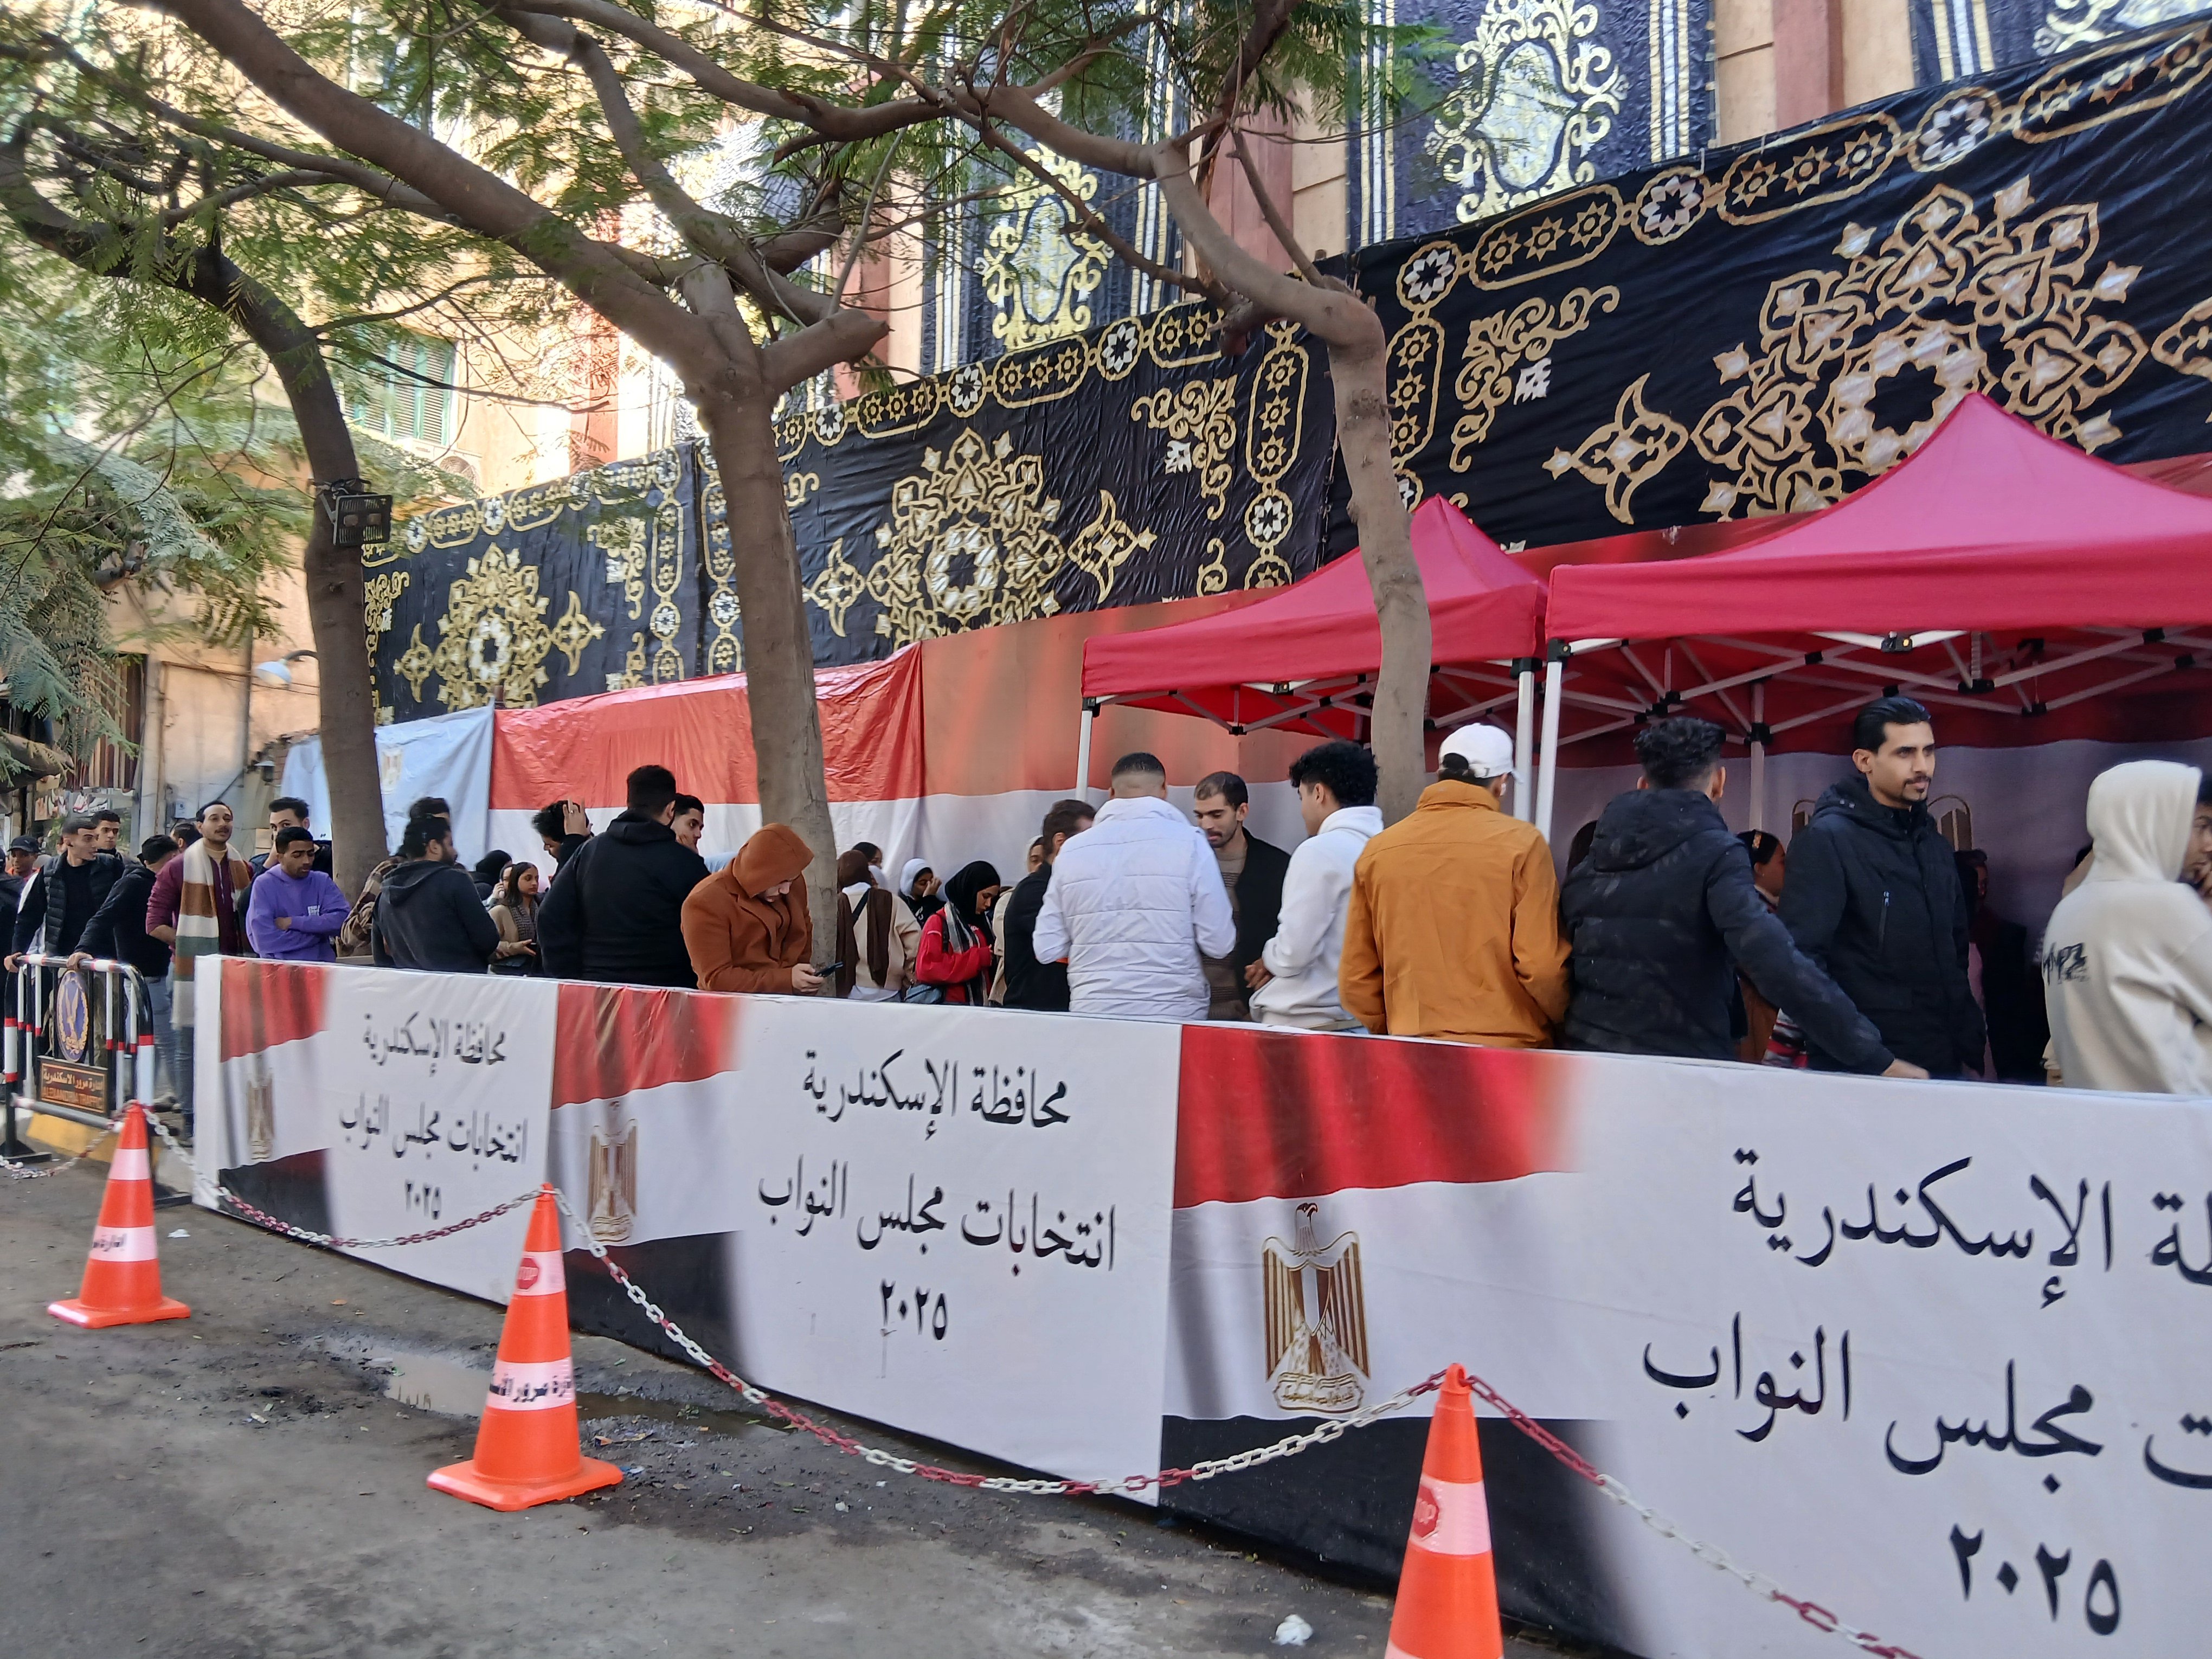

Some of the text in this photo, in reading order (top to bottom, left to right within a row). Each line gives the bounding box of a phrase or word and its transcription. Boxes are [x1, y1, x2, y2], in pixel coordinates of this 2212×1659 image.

[363, 1011, 508, 1078] محافظة الإسكندرية
[802, 1048, 1071, 1141] محافظة الإسكندرية
[338, 1091, 529, 1172] انتخابات مجلس النواب
[404, 1178, 442, 1221] ٢٠٢٥
[757, 1154, 1116, 1277] انتخابات مجلس النواب
[1732, 1147, 2114, 1309] الإسكندرية
[879, 1278, 949, 1341] ٢٠٢٥
[1642, 1311, 1852, 1443] النواب
[1883, 1358, 2105, 1495] مجلس
[1948, 1523, 2122, 1636] ٢٠٢٥
